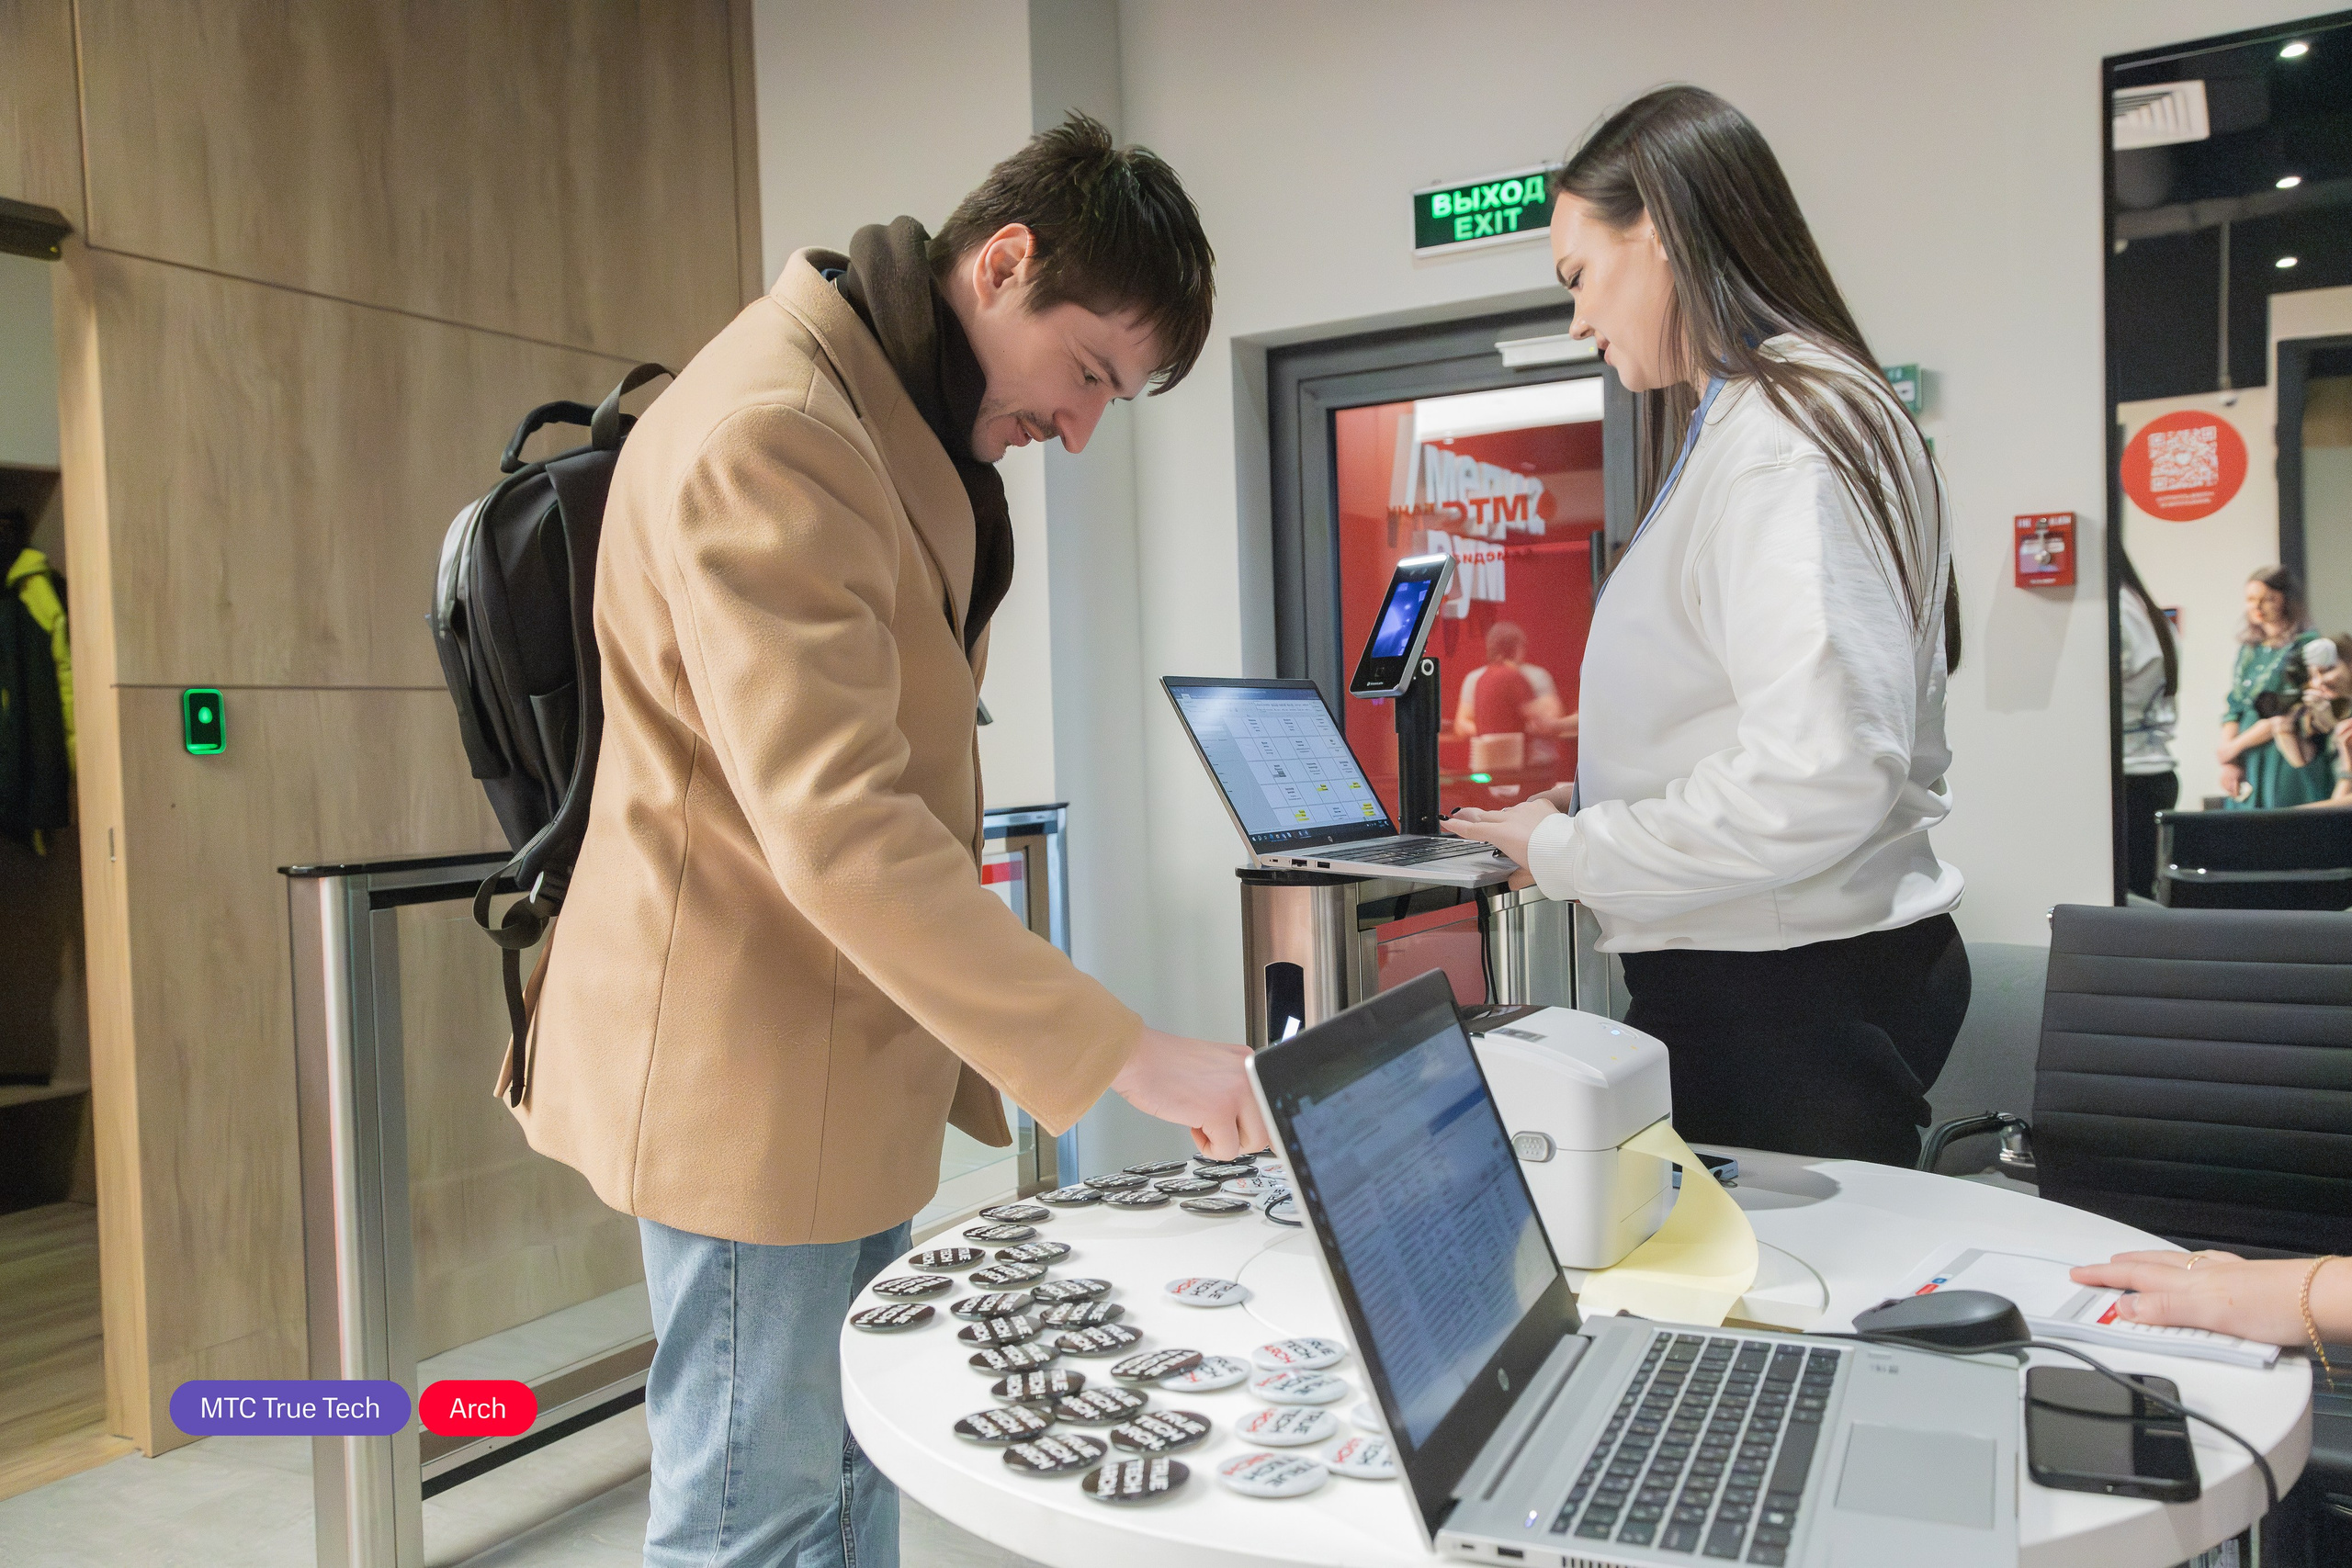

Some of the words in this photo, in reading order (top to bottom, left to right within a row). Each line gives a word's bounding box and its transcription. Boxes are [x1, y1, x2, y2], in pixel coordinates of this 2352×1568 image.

[1431, 175, 1546, 219] ВЫХОД
[1453, 207, 1523, 242] EXIT
[1028, 1370, 1046, 1395] TECH
[1051, 1368, 1069, 1393] TRUE
[1113, 1421, 1166, 1451] ARCH
[1135, 1415, 1187, 1441] TECH
[1154, 1410, 1206, 1435] TRUE
[1035, 1436, 1080, 1463] TECH
[1057, 1433, 1102, 1459] TRUE
[1097, 1461, 1120, 1496] ARCH
[1123, 1459, 1145, 1495] TECH
[1148, 1457, 1170, 1492] TRUE
